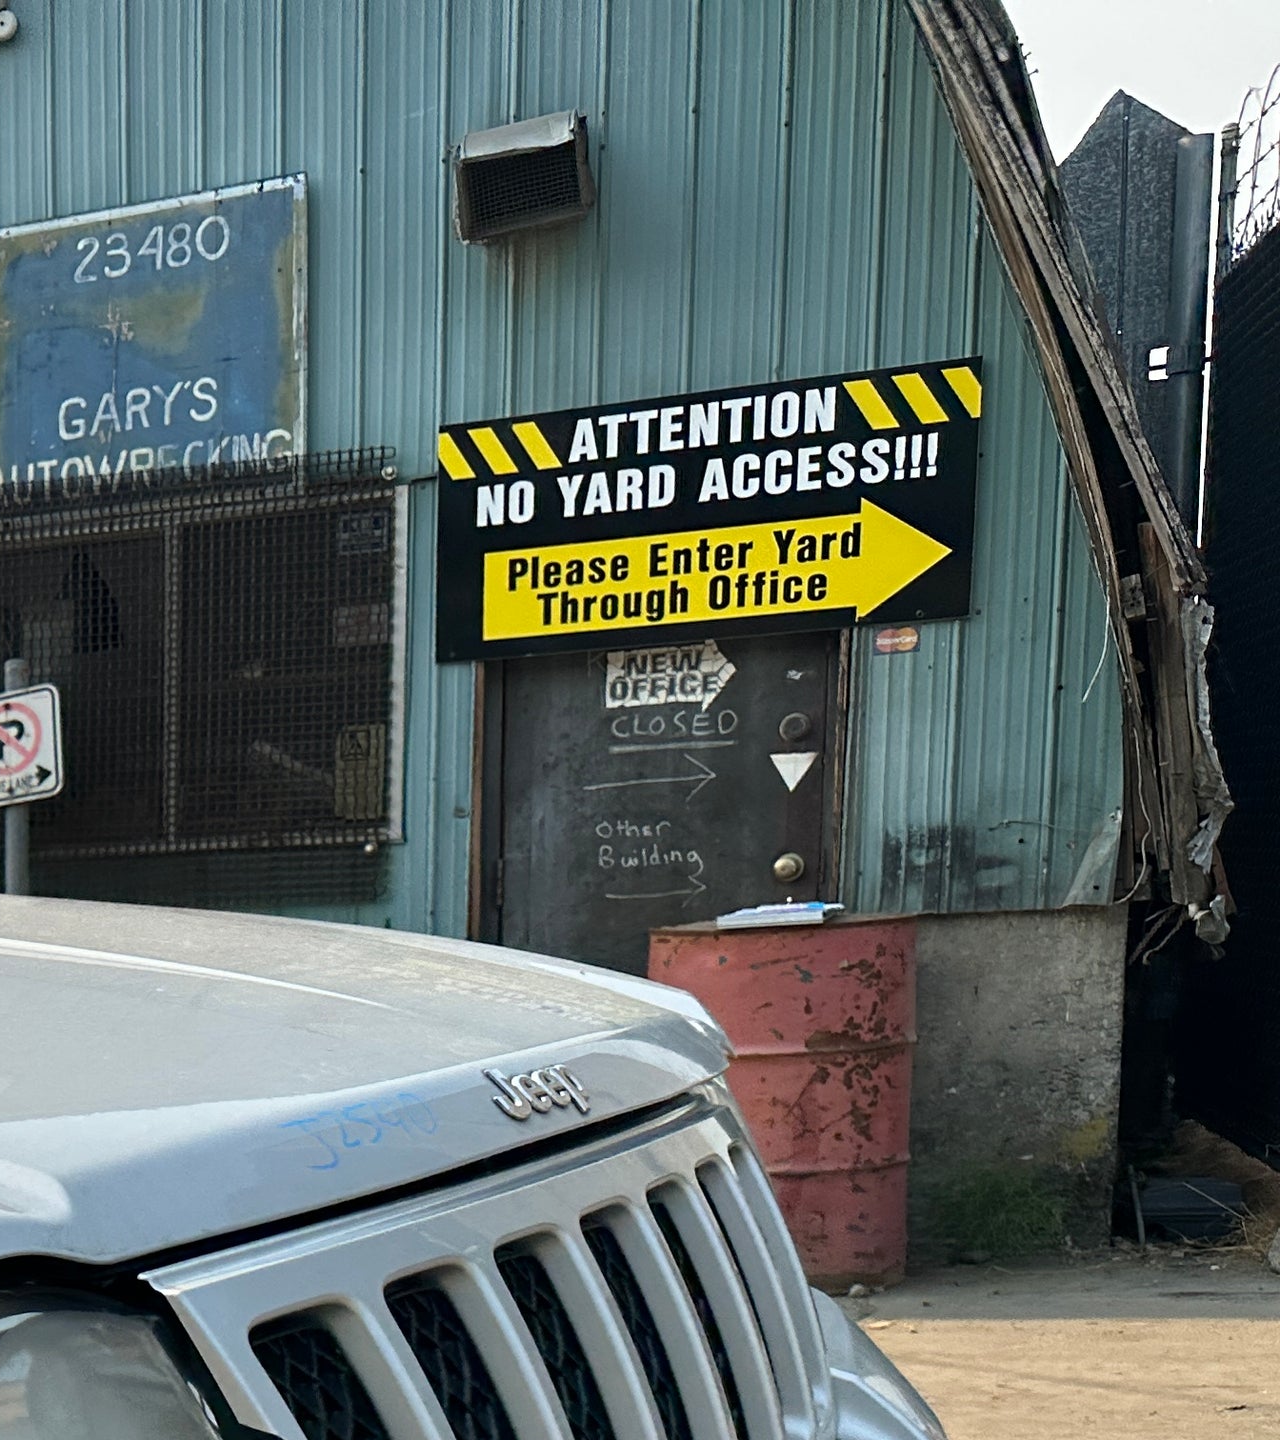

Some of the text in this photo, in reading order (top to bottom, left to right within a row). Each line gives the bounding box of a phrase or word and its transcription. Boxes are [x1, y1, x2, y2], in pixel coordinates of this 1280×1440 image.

[73, 214, 231, 284] 23480
[57, 376, 219, 441] GARY'S
[567, 386, 837, 464] ATTENTION
[475, 432, 940, 527] NO YARD ACCESS!!!
[507, 522, 862, 592] Please Enter Yard
[537, 569, 828, 627] Through Office
[609, 671, 721, 701] OFFICE
[626, 648, 702, 676] NEW
[611, 708, 738, 738] CLOSED
[595, 819, 672, 839] Other
[598, 843, 704, 876] Building
[482, 1063, 591, 1122] Jeep
